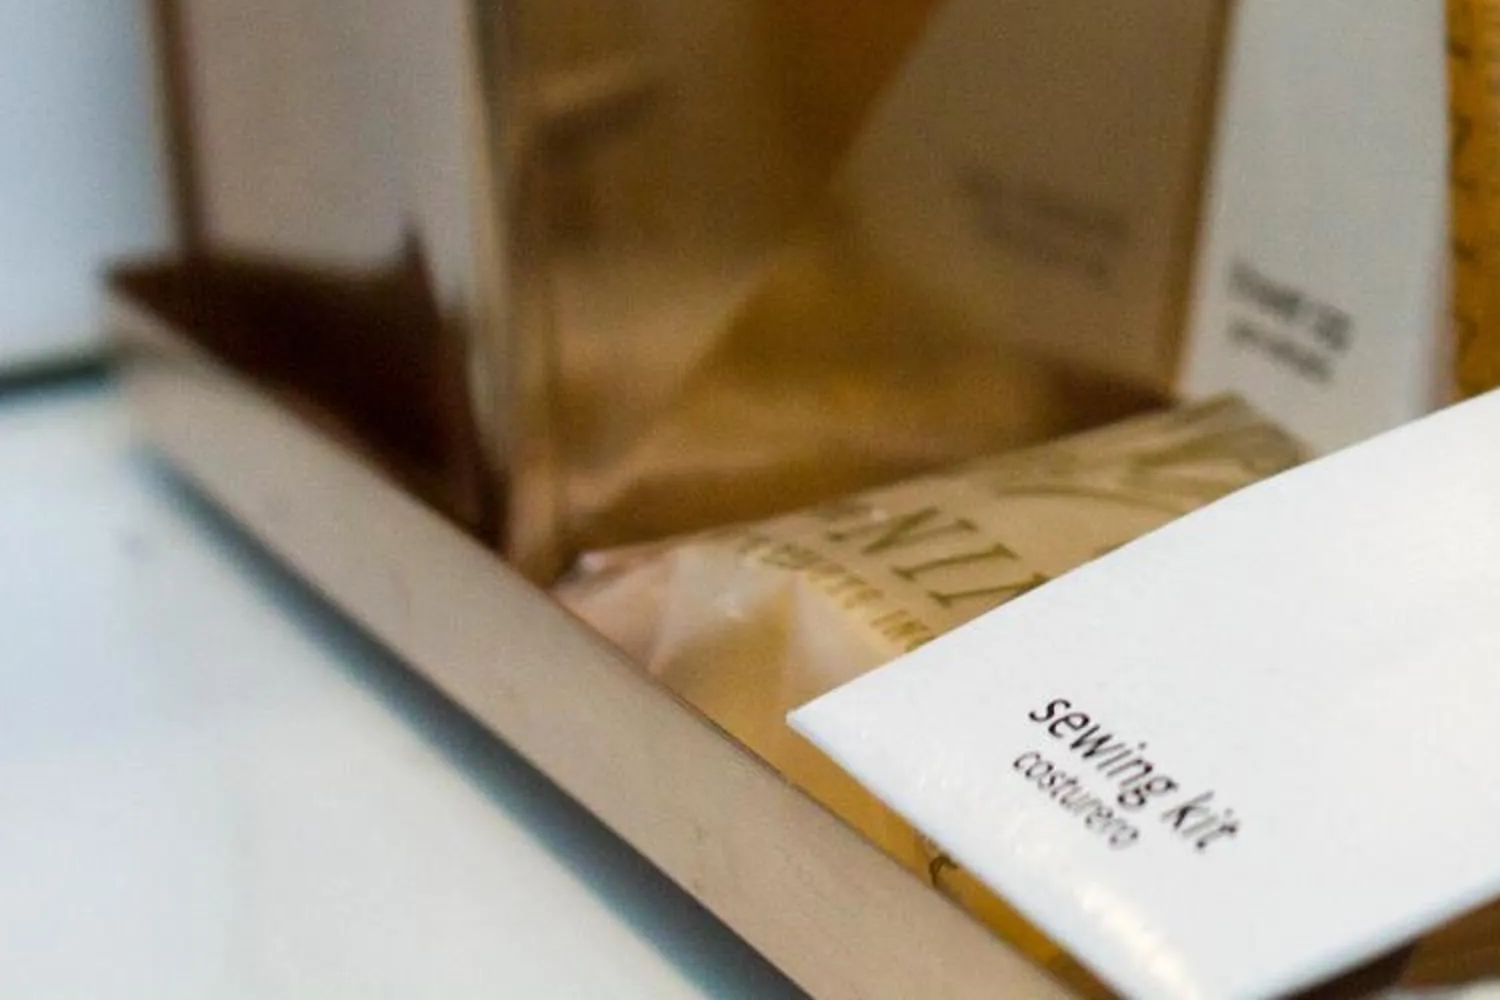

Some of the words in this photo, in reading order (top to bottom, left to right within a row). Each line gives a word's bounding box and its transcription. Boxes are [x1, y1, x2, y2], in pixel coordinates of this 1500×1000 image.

[1012, 750, 1141, 850] costurero
[1028, 698, 1179, 809] sewing
[1161, 789, 1241, 851] kit
